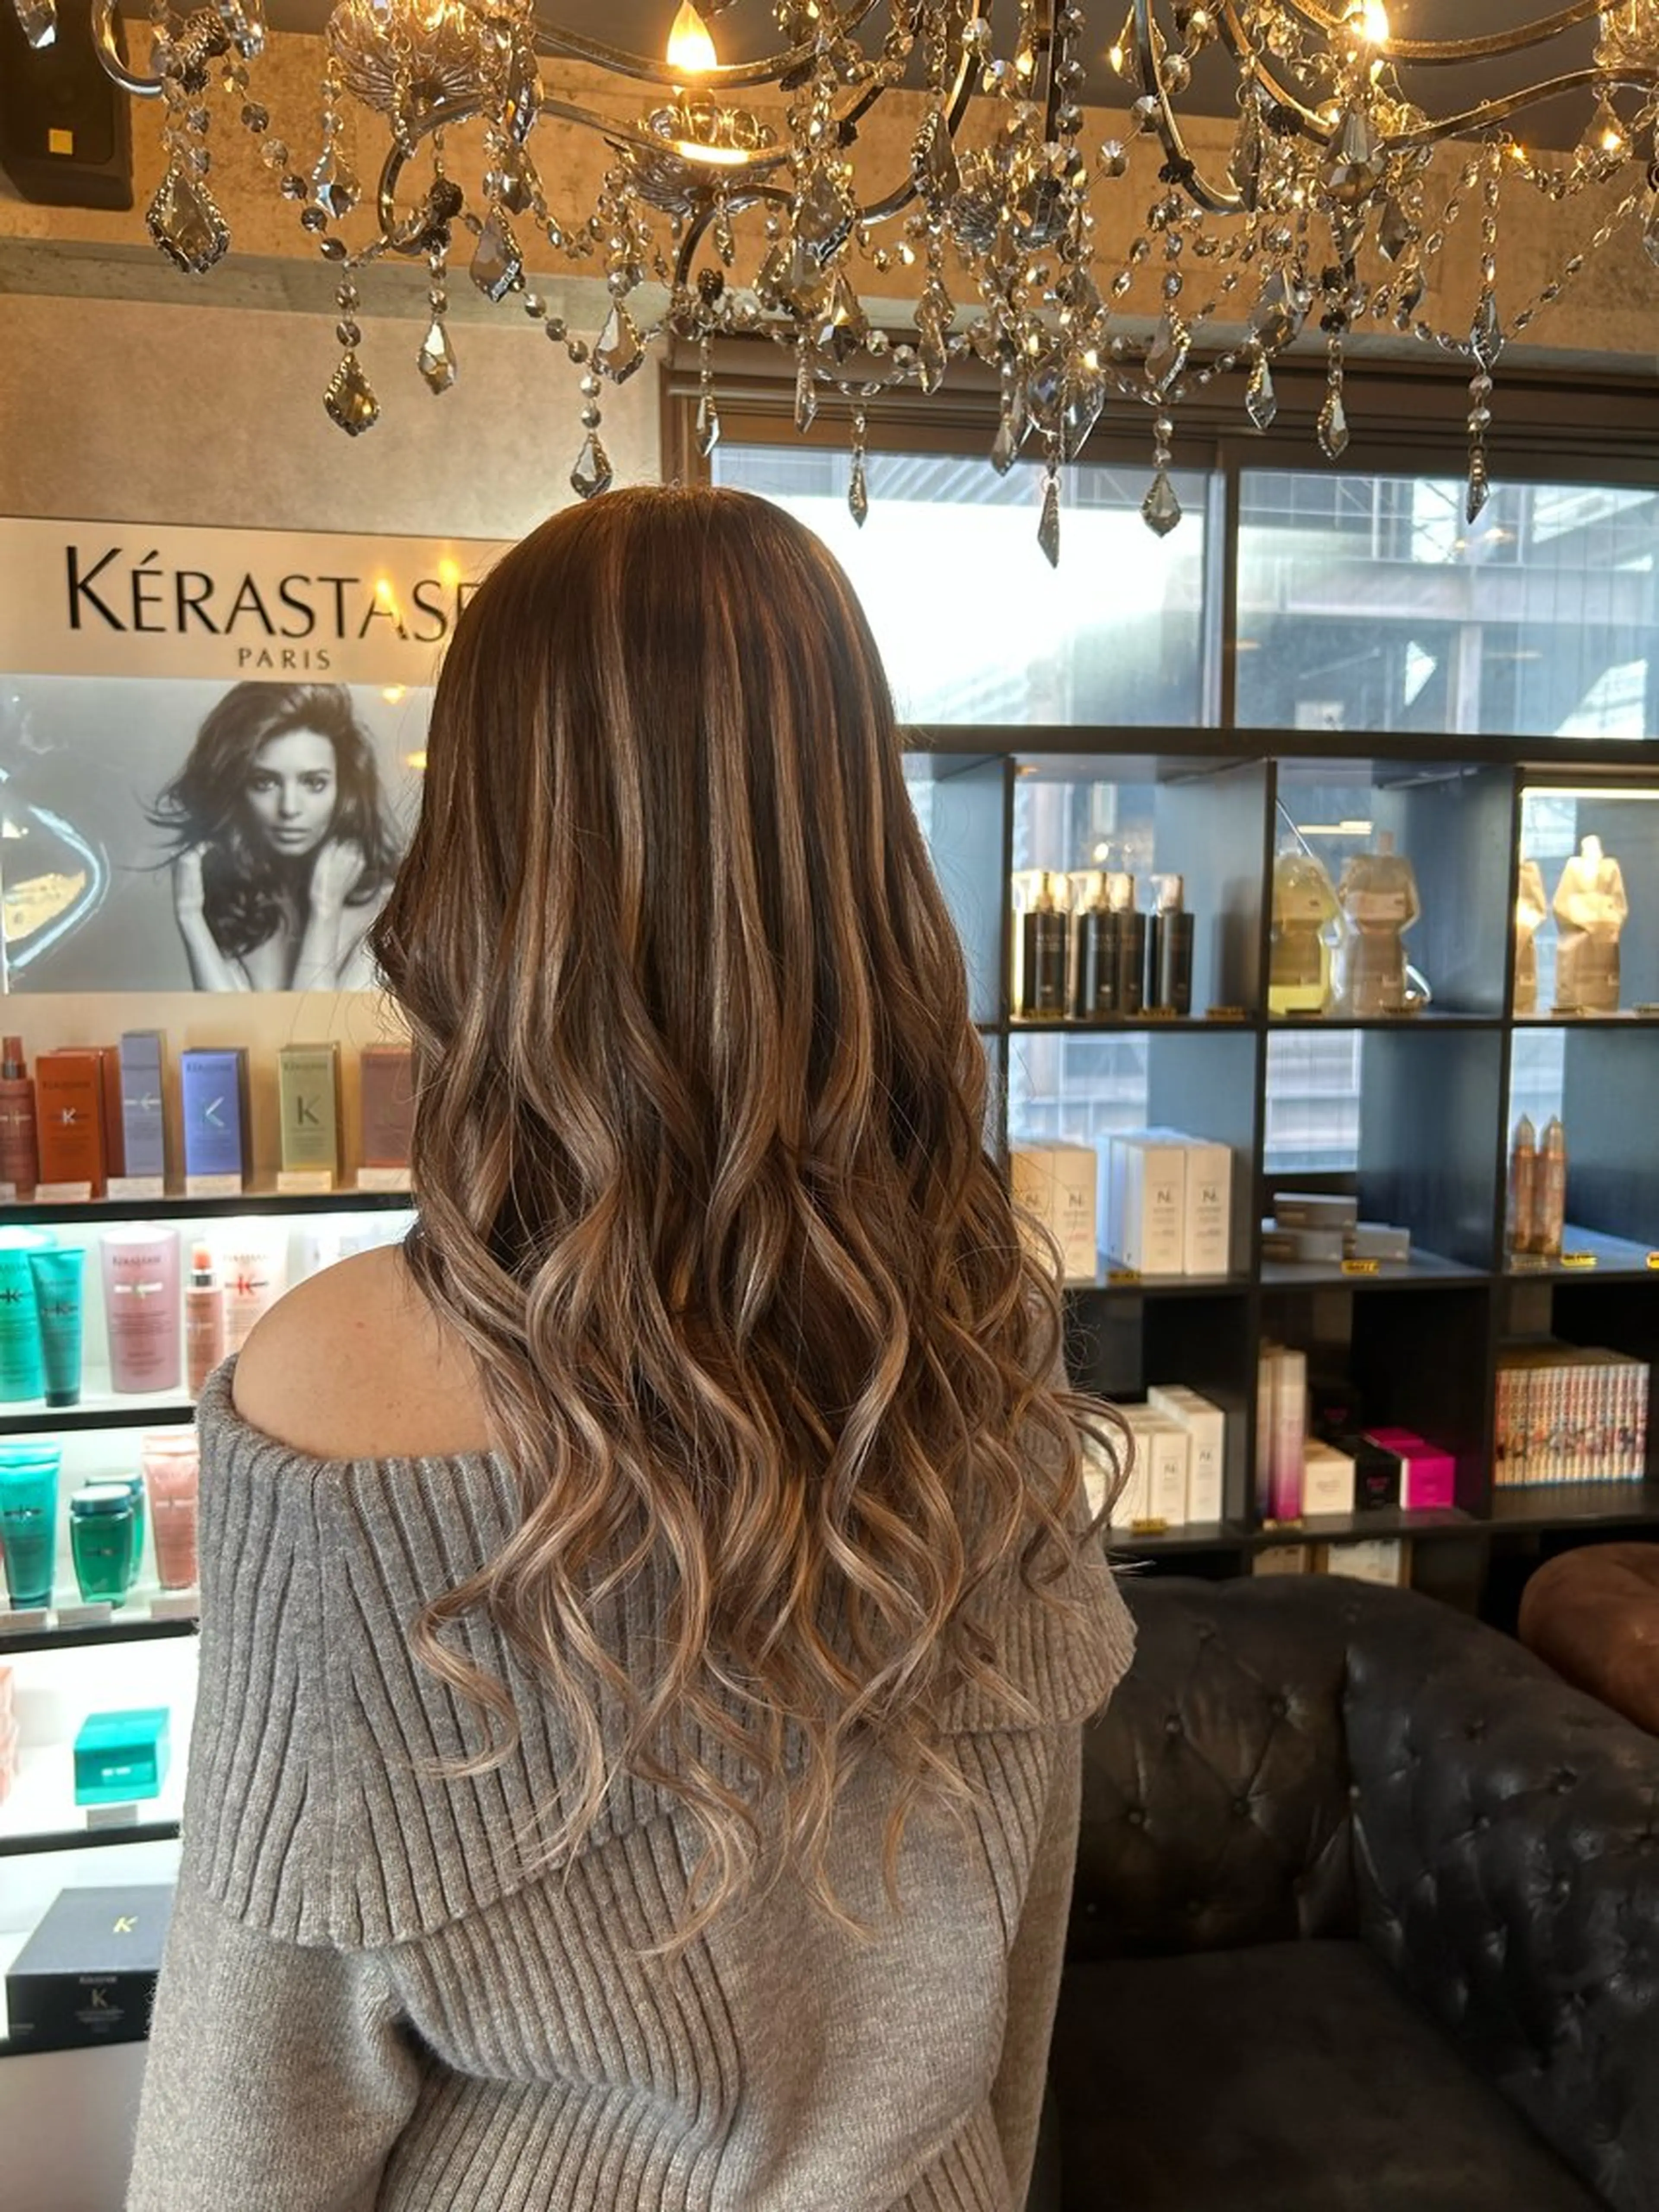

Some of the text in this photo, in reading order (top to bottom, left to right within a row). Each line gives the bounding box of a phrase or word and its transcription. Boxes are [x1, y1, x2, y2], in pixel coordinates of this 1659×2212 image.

[238, 647, 331, 670] PARIS
[112, 1916, 139, 1933] K
[92, 1988, 108, 2007] K
